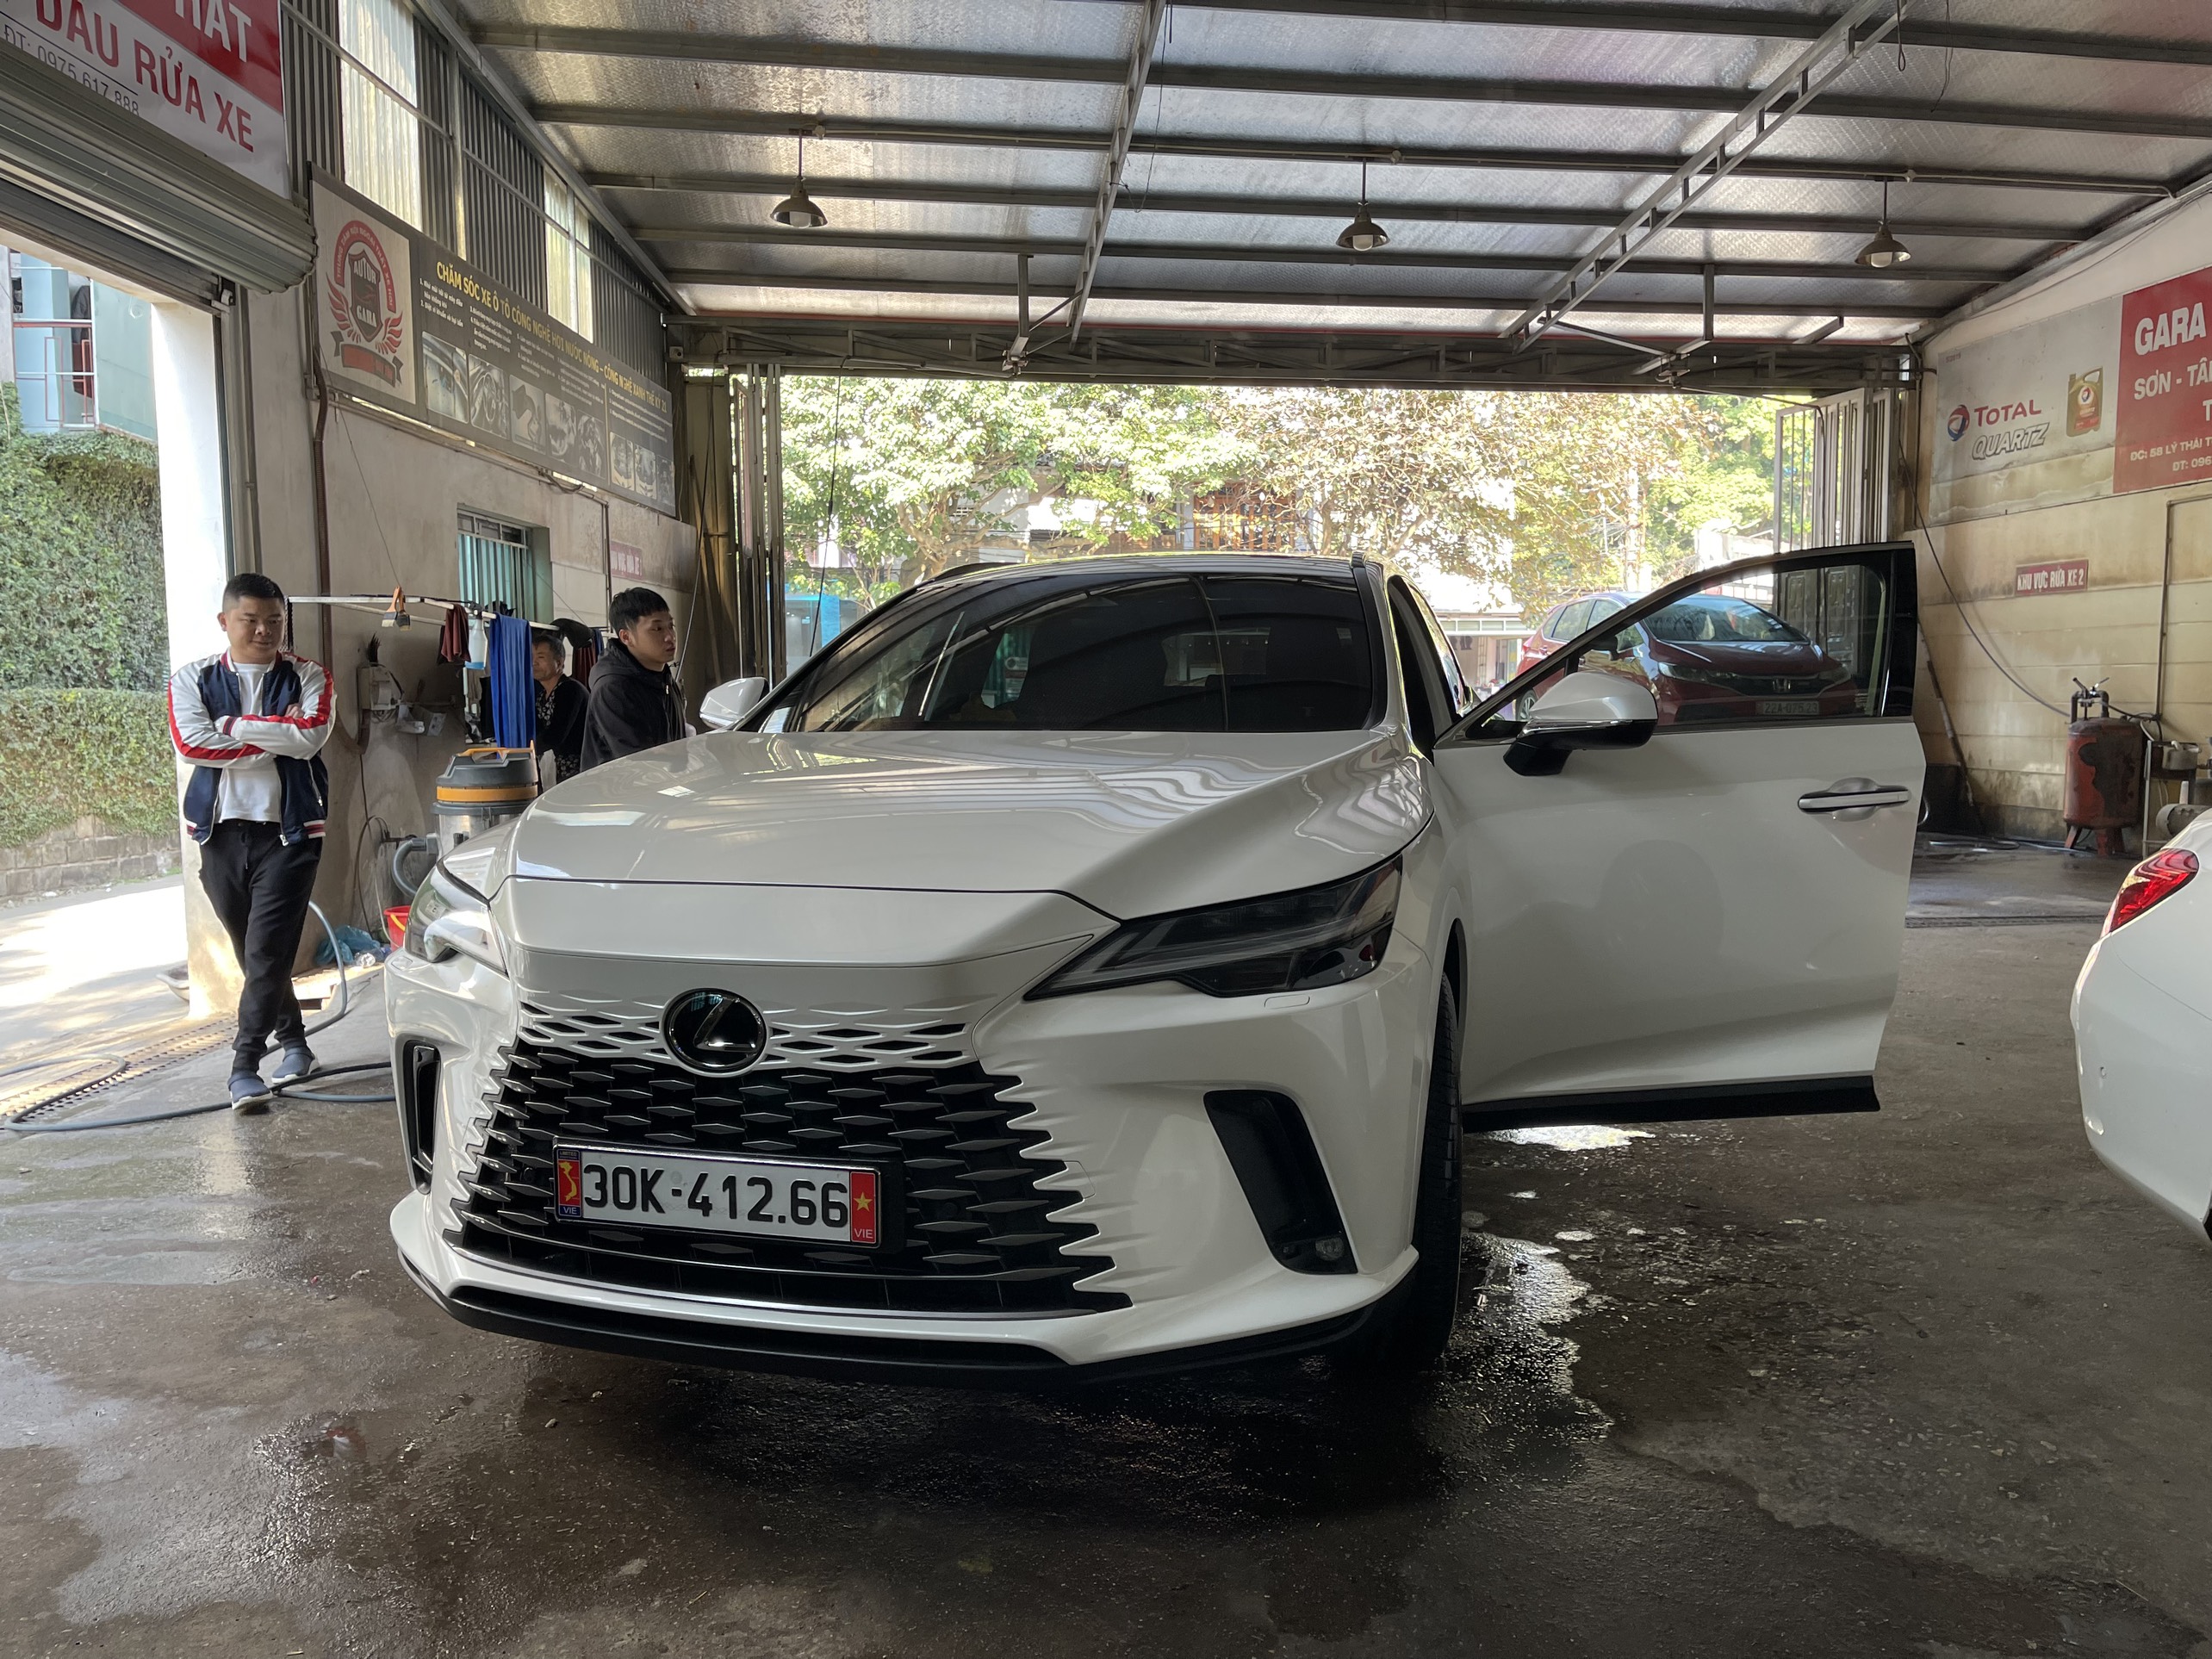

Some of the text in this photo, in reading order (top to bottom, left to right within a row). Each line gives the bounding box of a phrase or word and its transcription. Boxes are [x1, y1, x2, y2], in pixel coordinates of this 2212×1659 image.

[134, 39, 207, 124] RỬA
[214, 91, 254, 152] XE
[437, 261, 462, 290] CHĂM
[463, 275, 480, 301] SÓC
[481, 287, 492, 308] XE
[493, 290, 500, 312] Ô
[500, 297, 510, 319] TÔ
[512, 305, 531, 332] CÔNG
[604, 363, 618, 385] CÔNG
[2134, 302, 2207, 356] GARA
[2134, 370, 2172, 400] SƠN
[2187, 357, 2212, 387] TÂ
[1973, 399, 2041, 427] TOTAL
[1972, 421, 2050, 460] QUARTZ
[2067, 569, 2078, 587] XE
[2078, 568, 2085, 586] 2
[583, 1163, 849, 1229] 30K-412.66
[854, 1227, 873, 1240] VIE
